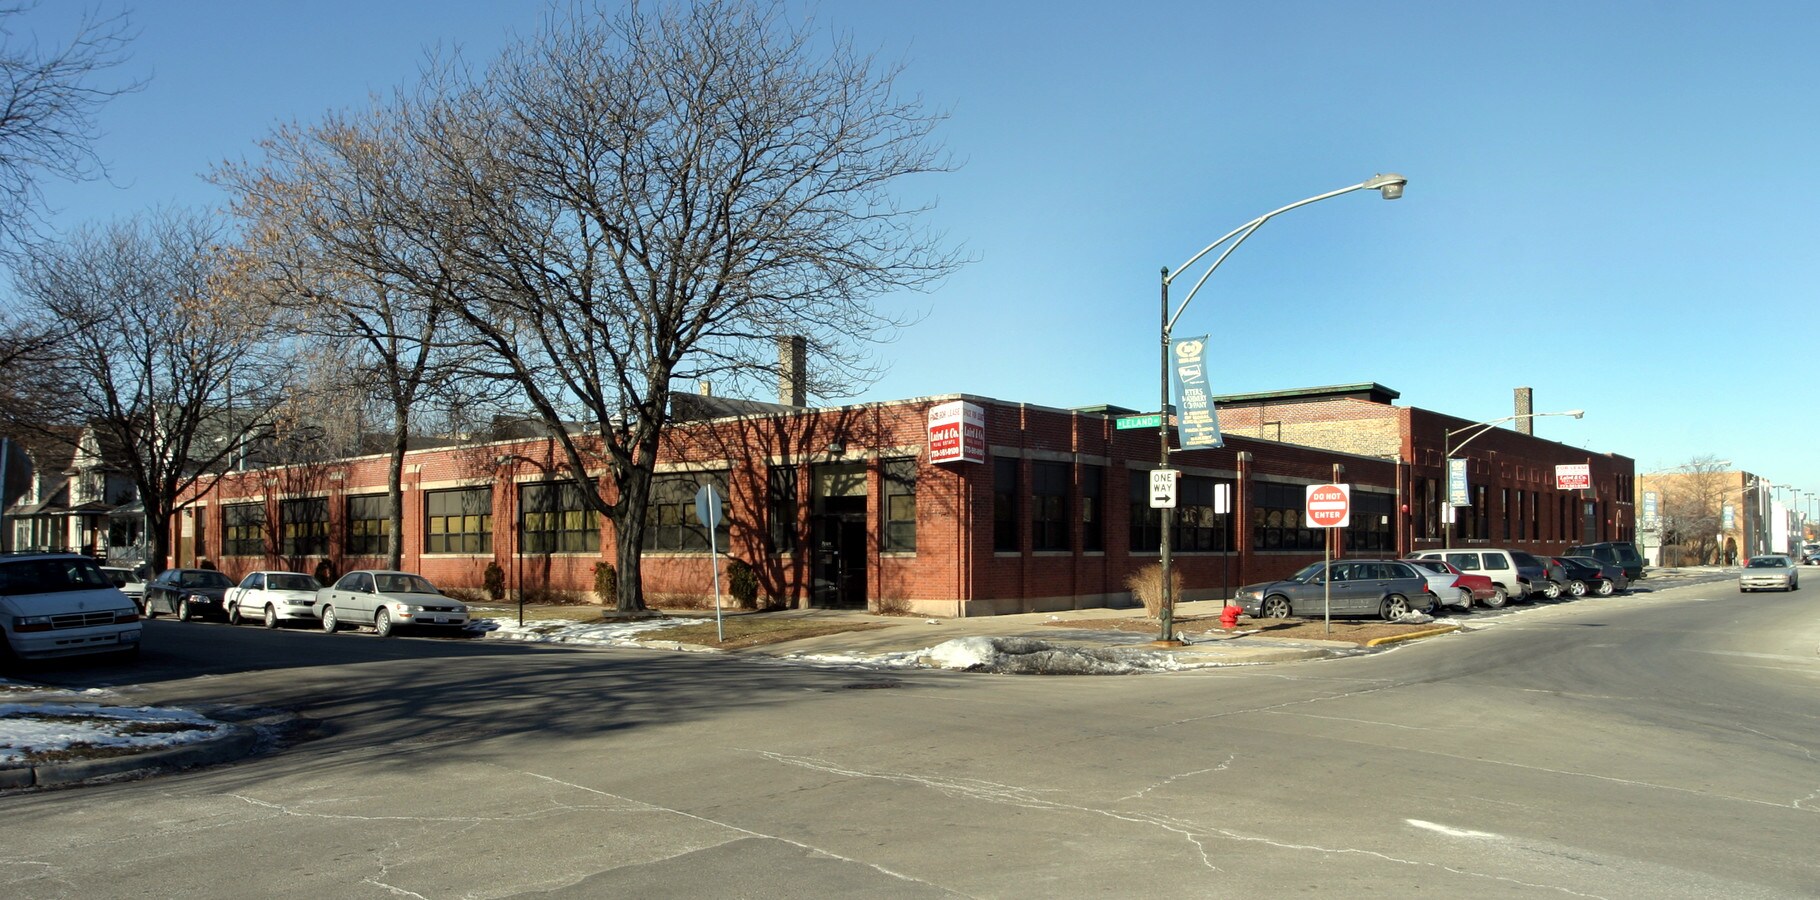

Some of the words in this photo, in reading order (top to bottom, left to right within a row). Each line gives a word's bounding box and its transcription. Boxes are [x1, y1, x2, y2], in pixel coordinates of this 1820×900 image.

[1123, 417, 1153, 428] LELAND
[931, 429, 943, 442] Laird
[944, 428, 949, 439] &
[965, 426, 974, 438] Laird
[1154, 474, 1171, 482] ONE
[1154, 484, 1172, 492] WAY
[1325, 492, 1341, 500] NOT
[1315, 511, 1340, 519] ENTER
